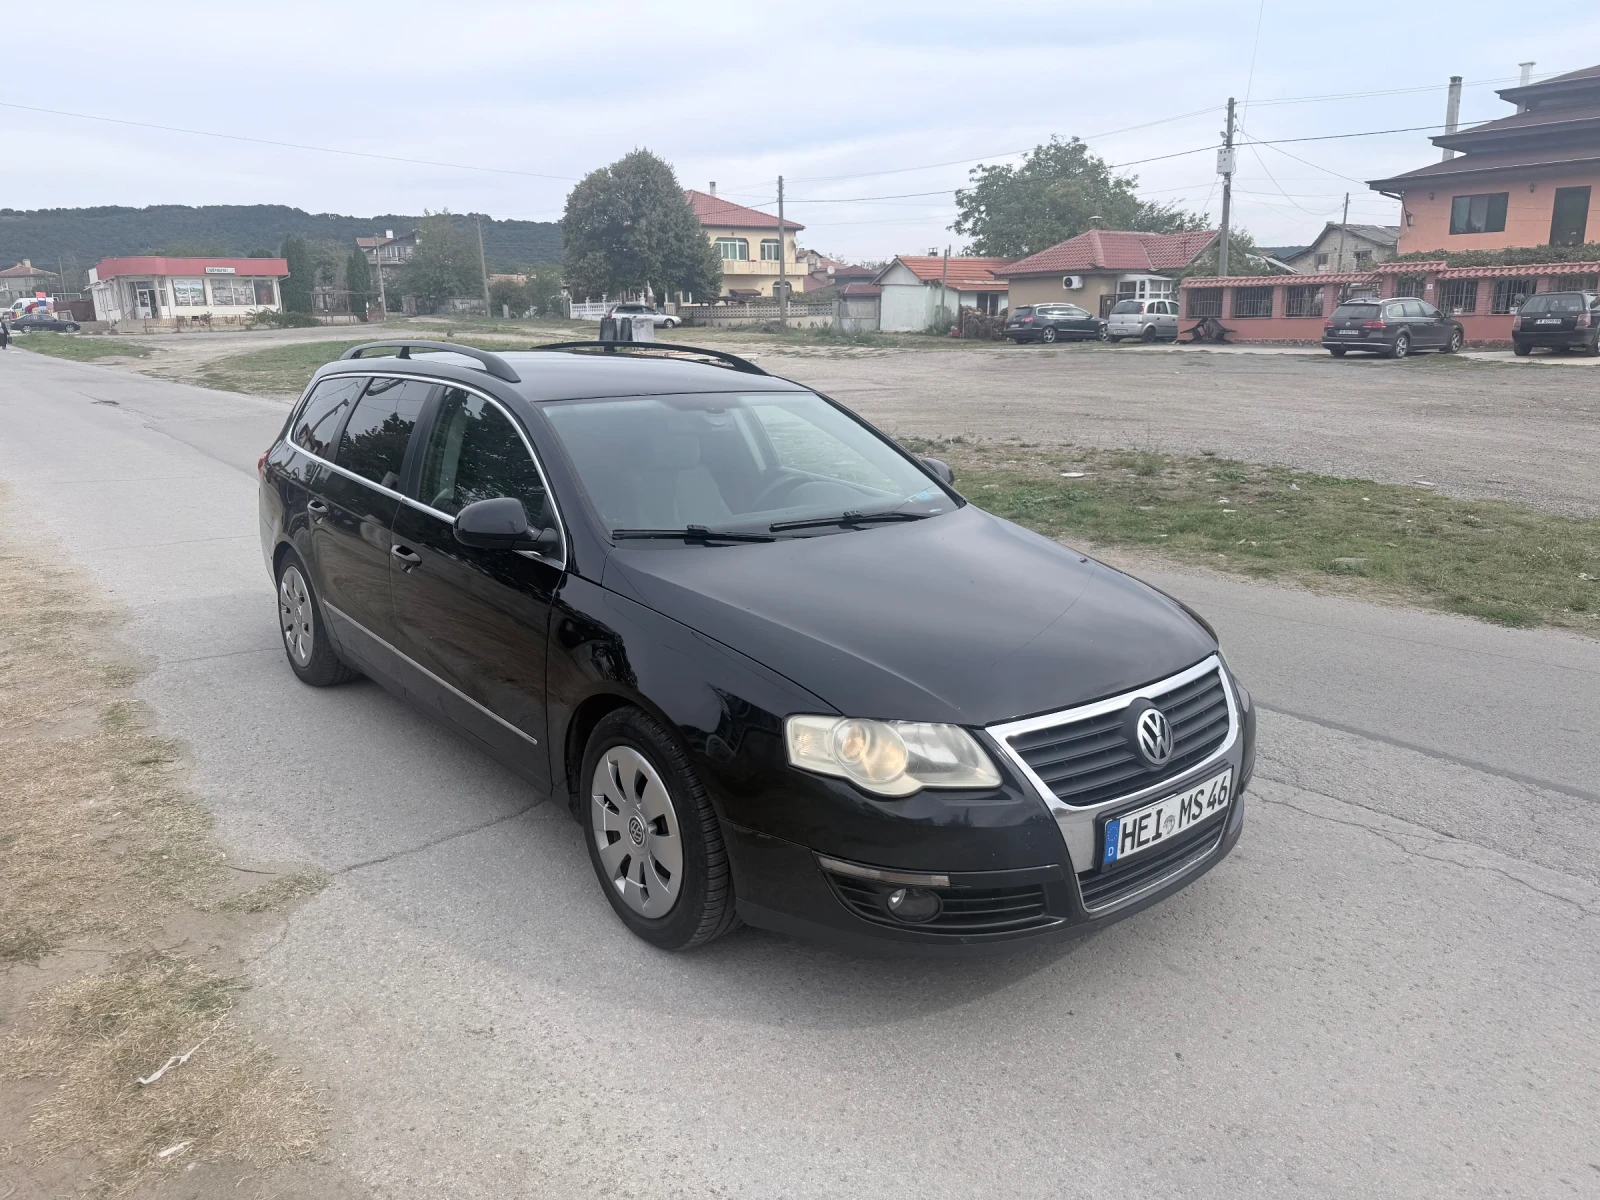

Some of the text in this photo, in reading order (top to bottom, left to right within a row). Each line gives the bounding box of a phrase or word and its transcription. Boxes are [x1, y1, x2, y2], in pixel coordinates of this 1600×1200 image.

[1120, 775, 1228, 855] HEI MS 46
[1109, 847, 1114, 856] D
